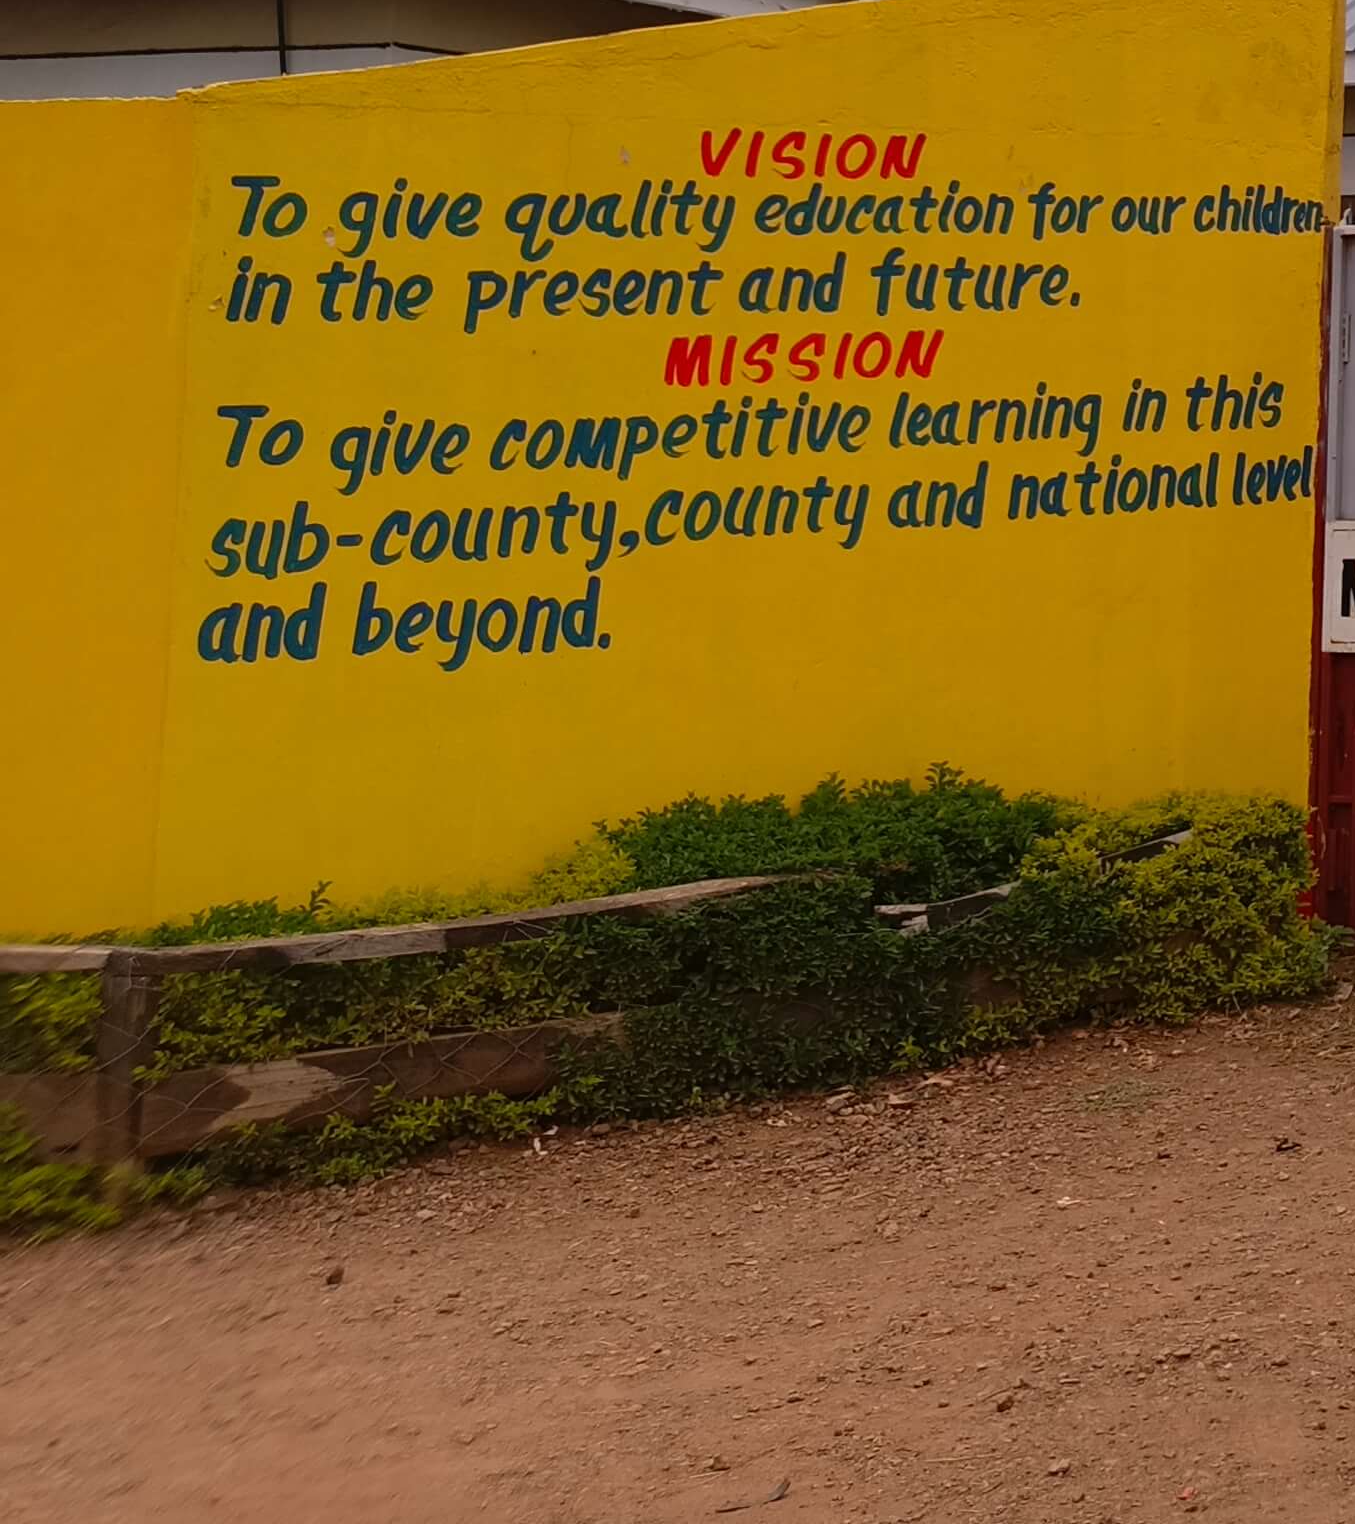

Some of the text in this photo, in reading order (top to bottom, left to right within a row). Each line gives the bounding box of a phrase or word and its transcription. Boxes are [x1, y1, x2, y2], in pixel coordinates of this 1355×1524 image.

[700, 127, 927, 181] VISION
[230, 175, 1326, 263] To give quality education for our children
[225, 247, 1080, 335] in the present and future.
[663, 329, 945, 388] MISSION
[216, 371, 1285, 497] To give competitive learning in this
[887, 460, 989, 530] and
[1007, 452, 1220, 521] national
[1231, 444, 1314, 506] level
[197, 575, 611, 673] and beyond.
